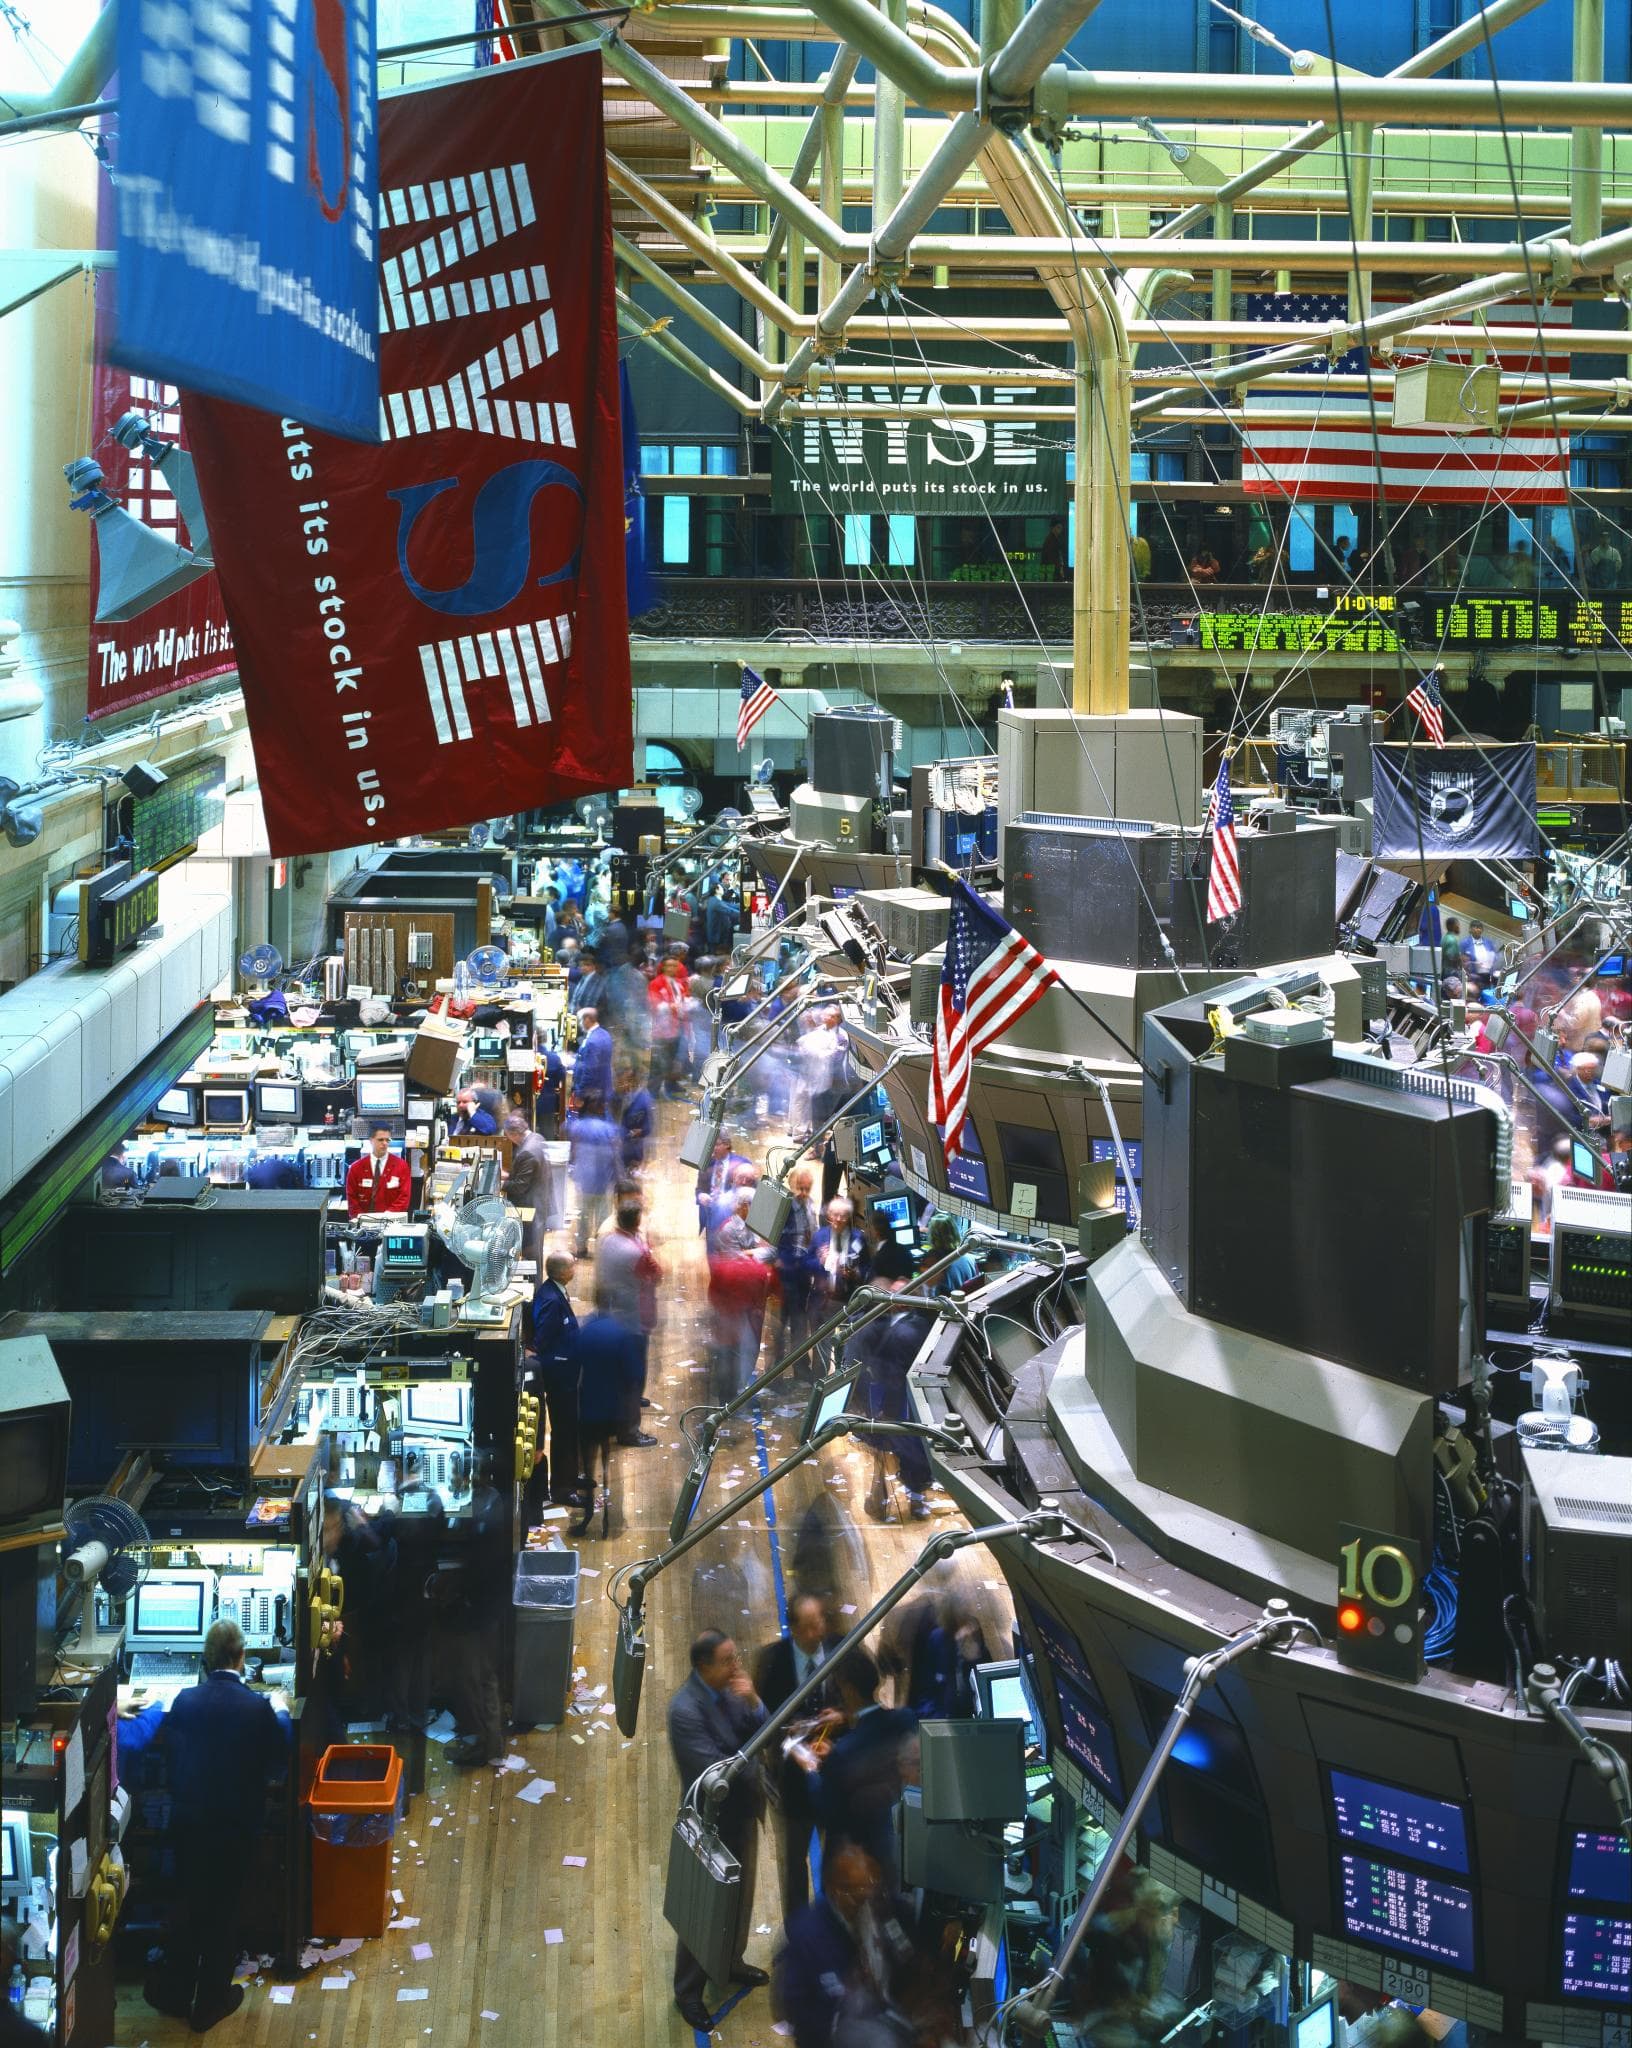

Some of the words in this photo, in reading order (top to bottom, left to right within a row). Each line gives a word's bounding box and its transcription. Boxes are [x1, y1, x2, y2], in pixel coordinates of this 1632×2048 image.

[280, 415, 313, 481] uts
[803, 385, 1037, 467] NYSE
[790, 479, 821, 493] The
[829, 479, 875, 493] world
[882, 480, 917, 497] puts
[924, 480, 945, 494] its
[952, 481, 996, 494] stock
[1004, 480, 1018, 494] in
[1025, 483, 1048, 494] us.
[299, 501, 329, 556] its
[97, 640, 127, 687] The
[219, 619, 234, 651] st
[314, 575, 364, 694] stock
[342, 710, 372, 750] in
[356, 768, 385, 827] us.
[840, 818, 851, 835] 5
[1340, 1538, 1414, 1608] 10
[1387, 1974, 1425, 1998] 2190
